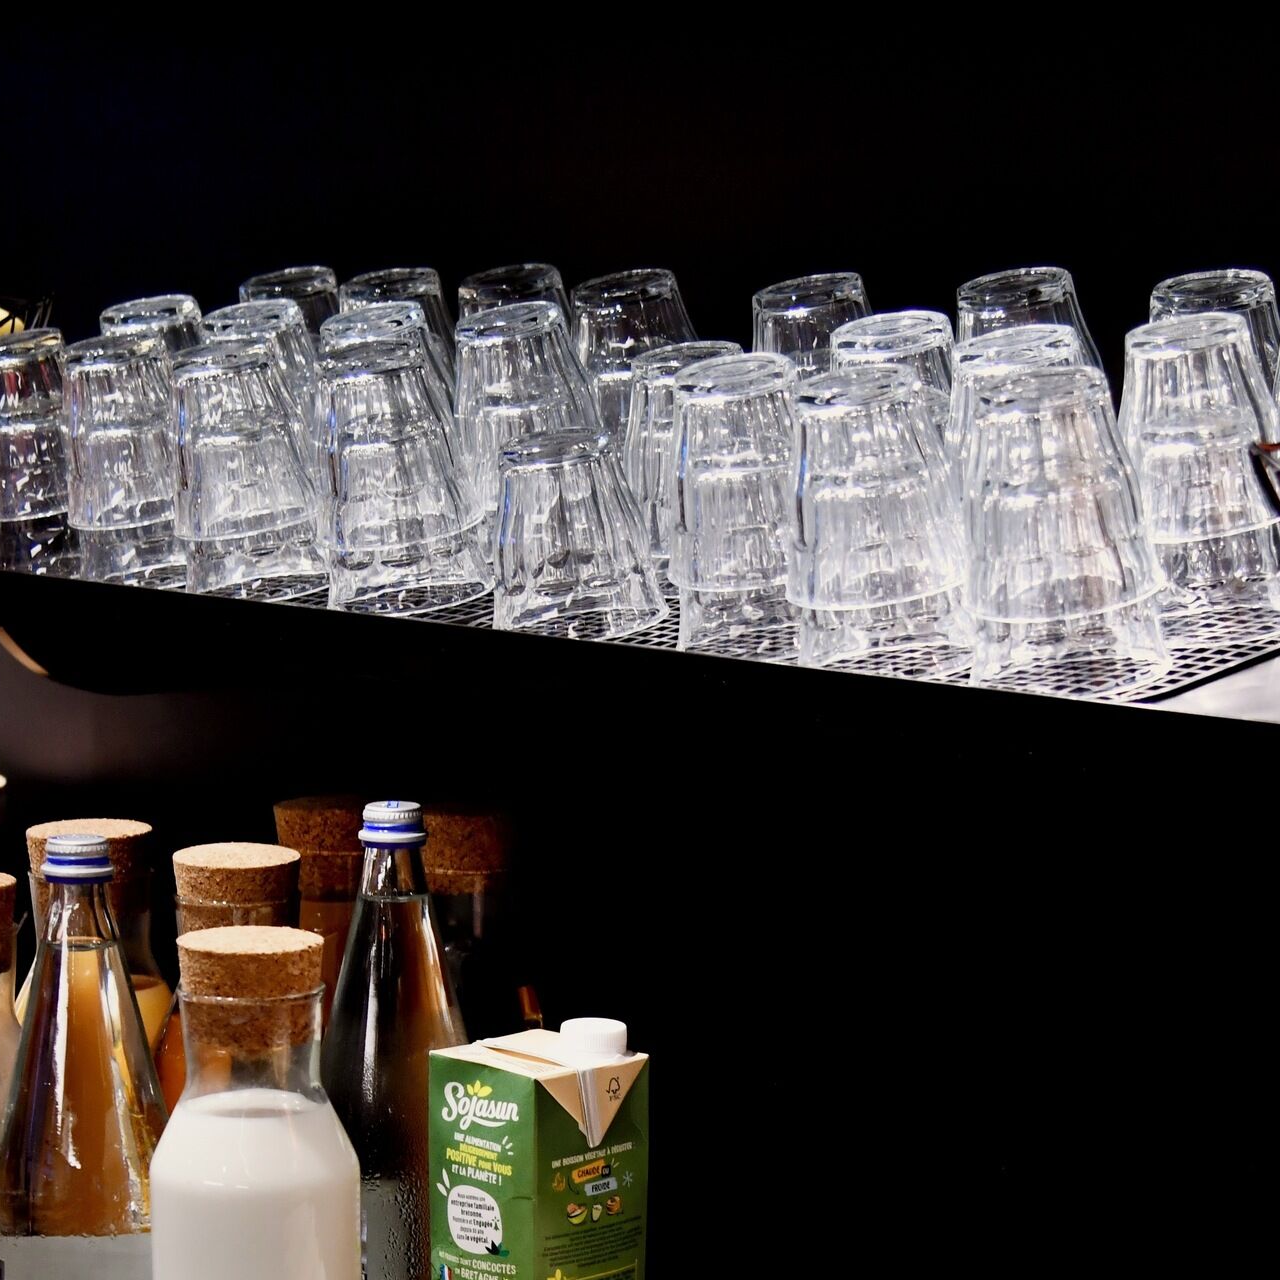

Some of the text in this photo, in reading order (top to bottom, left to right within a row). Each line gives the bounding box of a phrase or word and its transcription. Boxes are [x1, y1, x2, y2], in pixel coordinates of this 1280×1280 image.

[441, 1081, 519, 1130] Sojasun
[446, 1147, 477, 1167] POSITIVE
[492, 1162, 512, 1177] VOUS
[563, 1155, 584, 1166] BOISSON
[451, 1163, 460, 1174] ET
[460, 1166, 467, 1176] LA
[467, 1166, 497, 1185] PLANÈTE
[577, 1166, 600, 1178] CHAUDE
[591, 1181, 610, 1193] FROIDE
[460, 1257, 472, 1267] SONT
[472, 1258, 517, 1275] CONCOCTÉS
